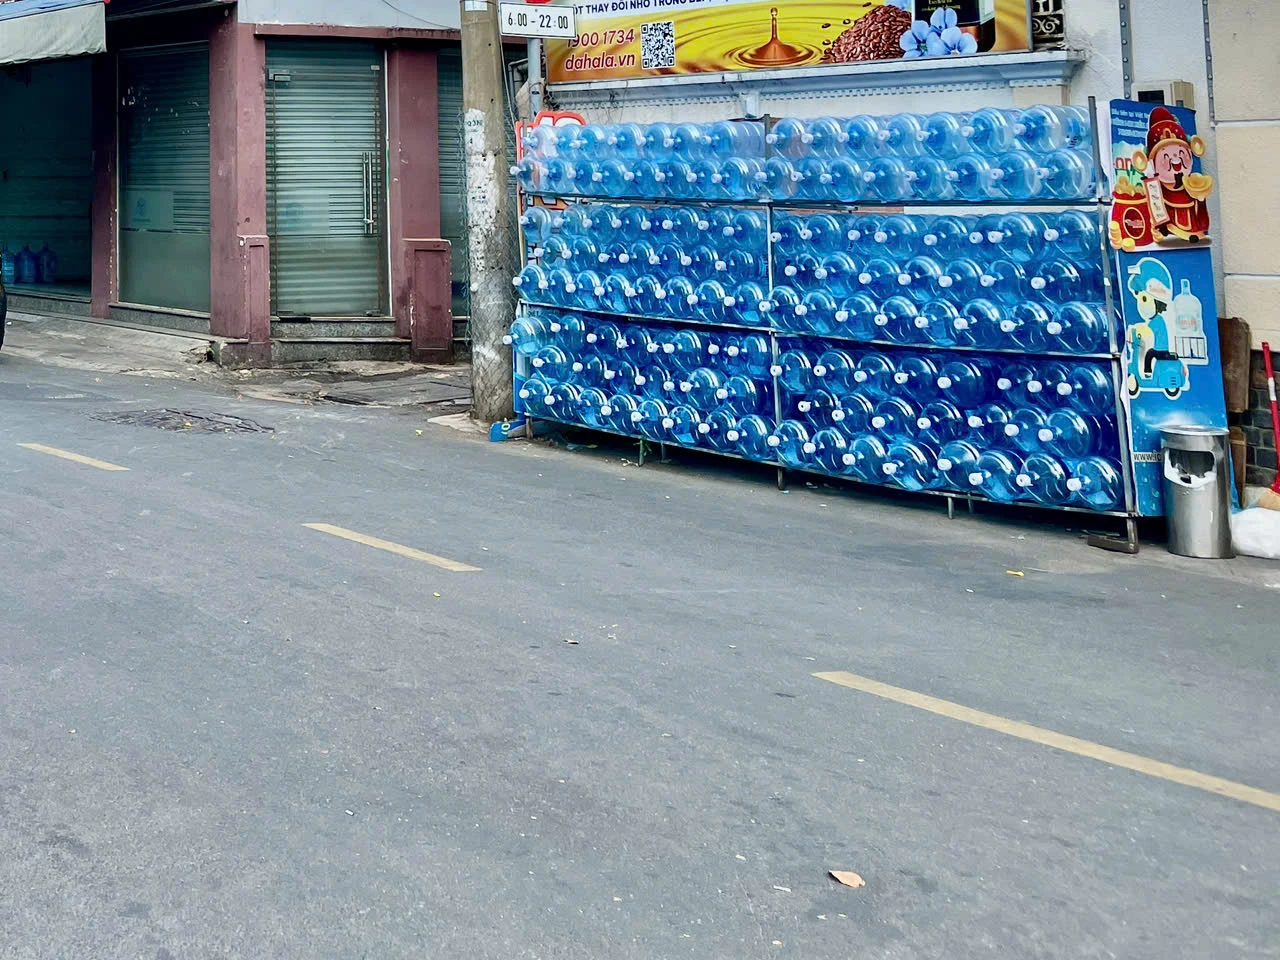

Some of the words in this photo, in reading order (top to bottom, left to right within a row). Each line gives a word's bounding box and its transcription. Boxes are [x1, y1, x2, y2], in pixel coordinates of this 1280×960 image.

[586, 2, 609, 15] THAY
[603, 29, 635, 46] 1734
[565, 52, 635, 71] dahala.vn
